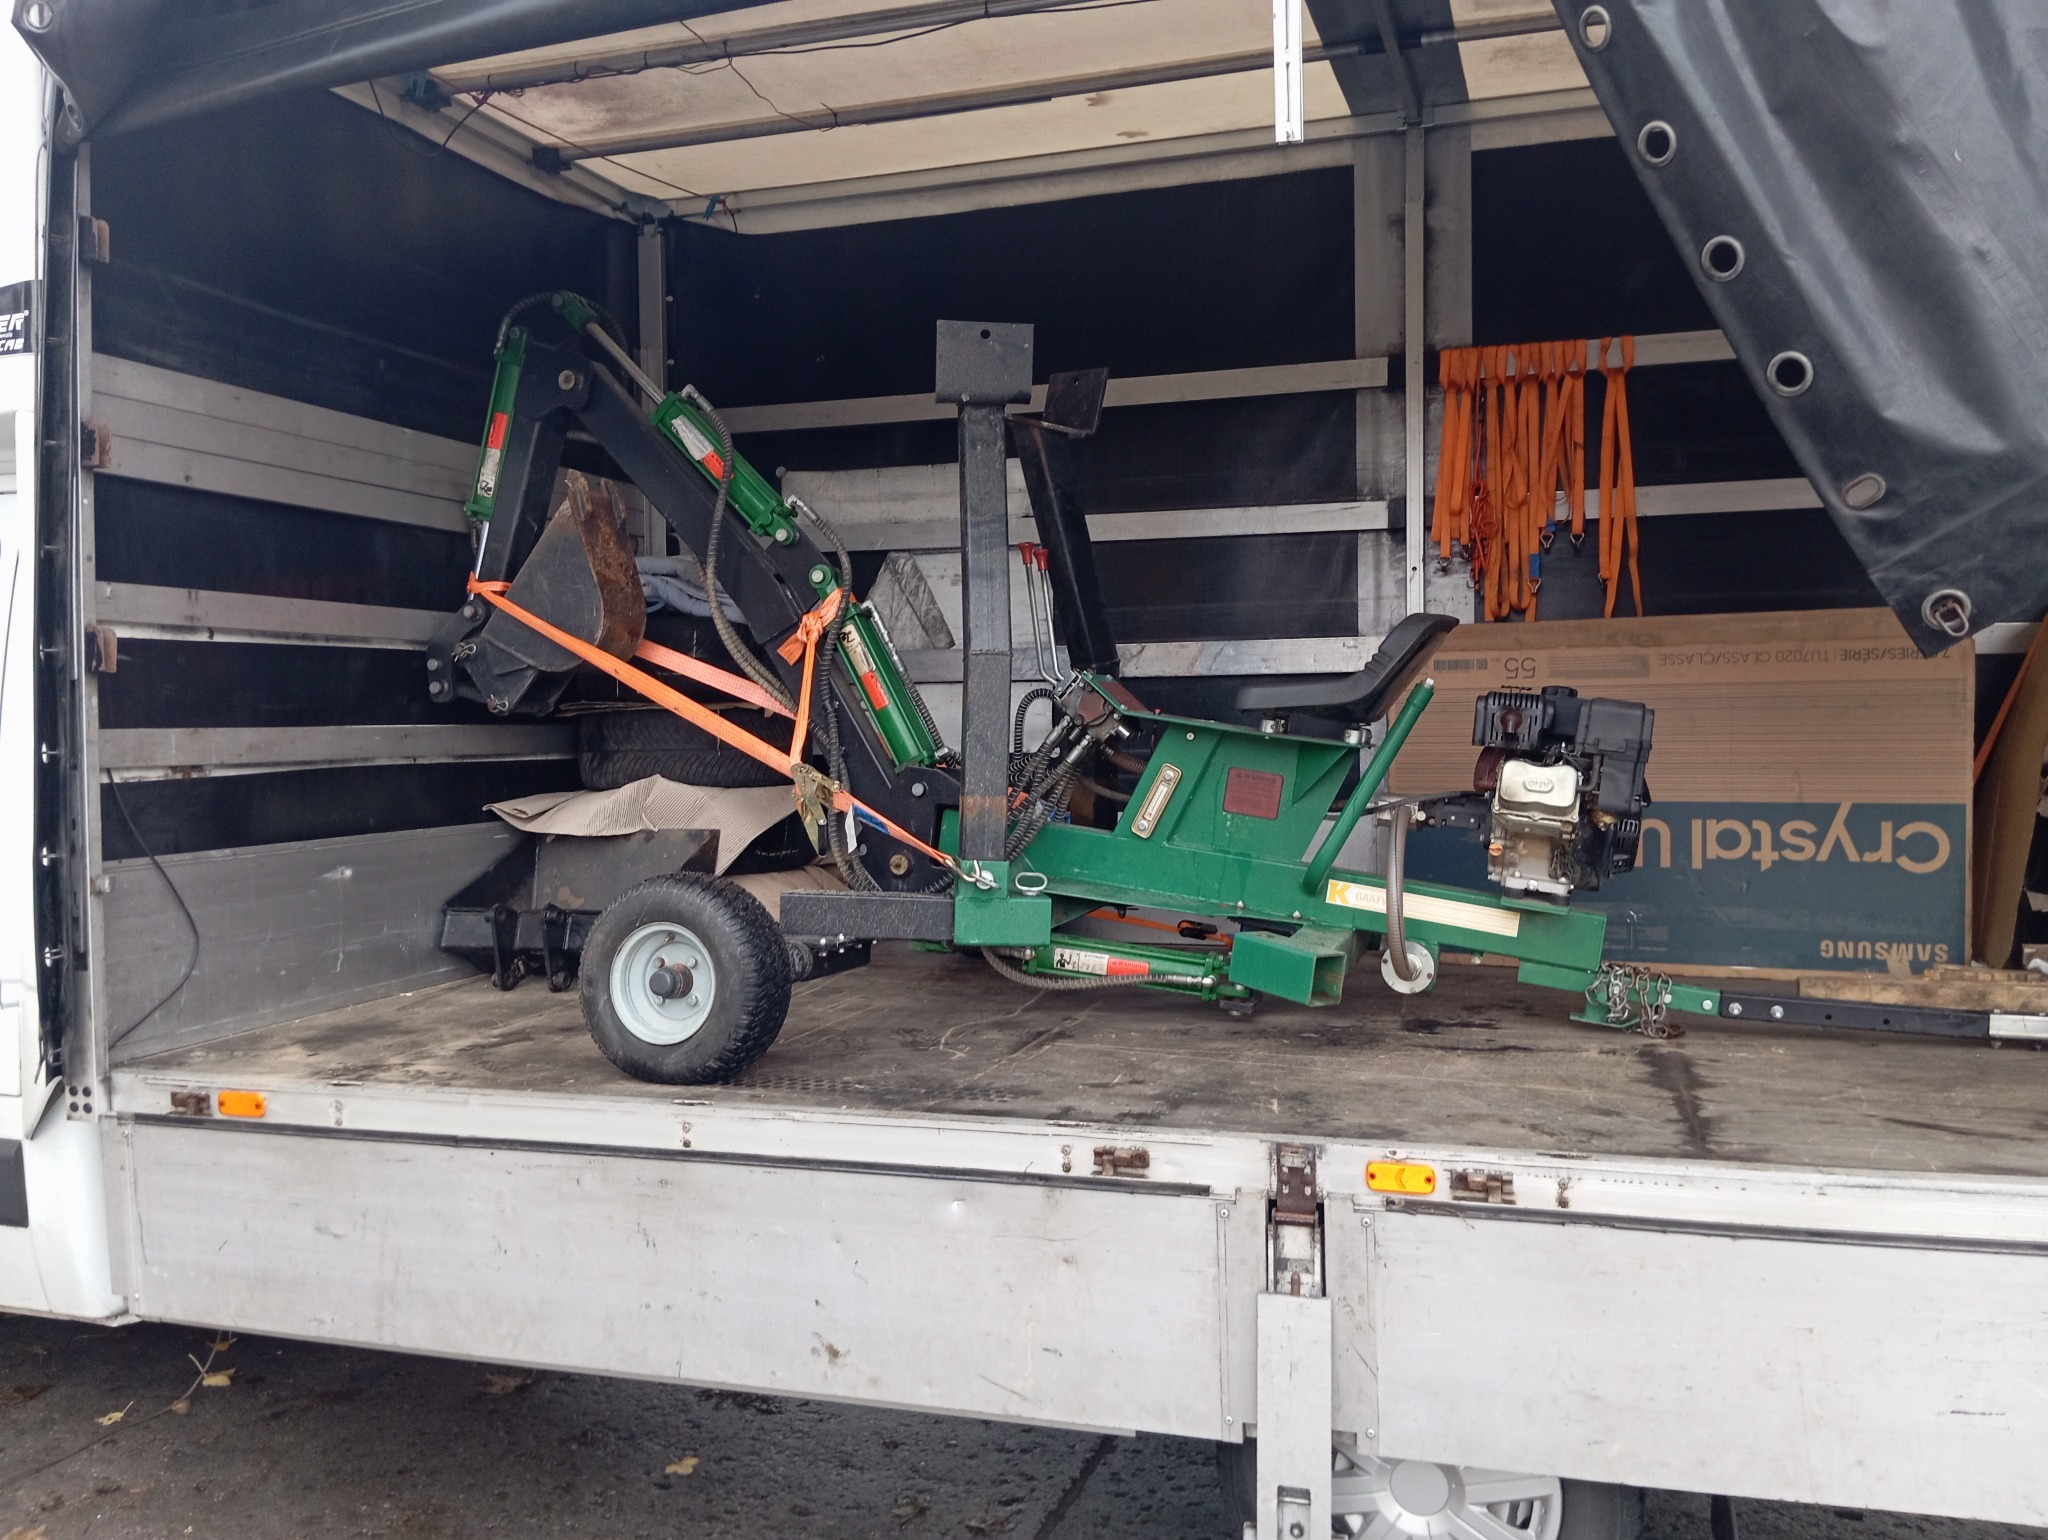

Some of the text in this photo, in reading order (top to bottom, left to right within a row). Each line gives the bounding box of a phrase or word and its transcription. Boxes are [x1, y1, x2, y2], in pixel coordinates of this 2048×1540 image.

[1658, 650, 1772, 666] CLASS/CLASSE
[1775, 649, 1831, 663] TU7020
[1840, 647, 1938, 663] RIES/SÉRIE
[1504, 657, 1536, 679] 55
[1691, 802, 1951, 874] Crystal
[1328, 881, 1351, 905] K
[1820, 939, 1949, 963] SAMSUNG
